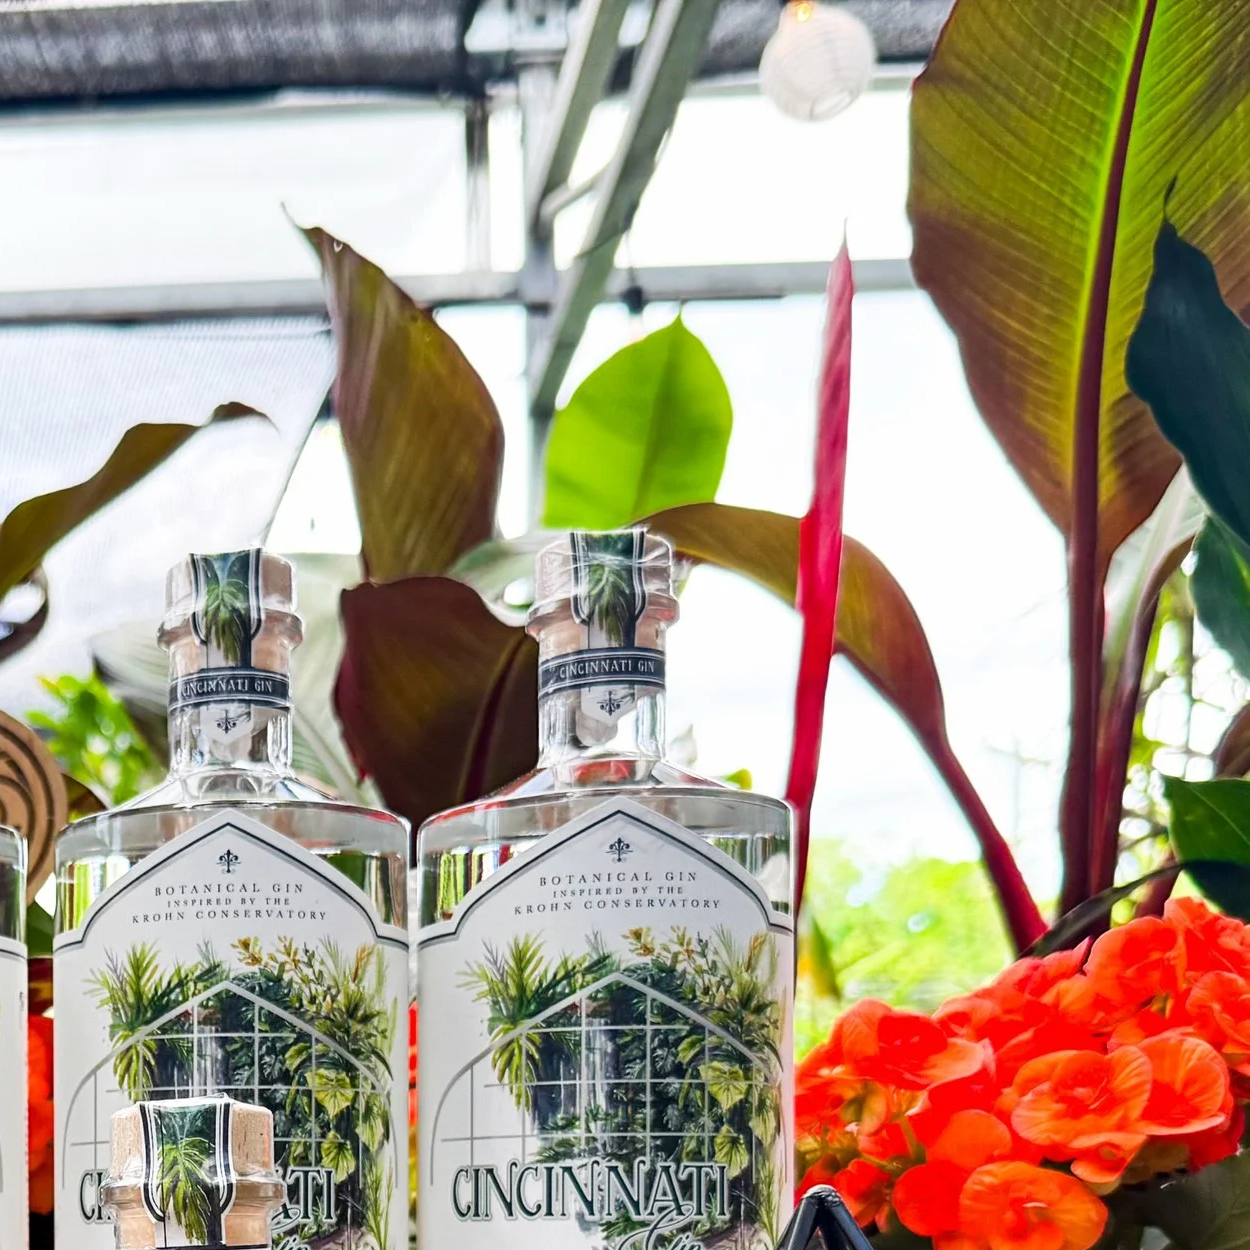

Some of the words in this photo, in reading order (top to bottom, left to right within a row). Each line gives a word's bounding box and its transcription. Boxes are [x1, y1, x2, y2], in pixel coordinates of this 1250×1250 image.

[559, 659, 632, 679] CINCINNATI
[637, 660, 655, 673] GIN
[254, 680, 273, 693] GIN
[539, 872, 652, 886] BOTANICAL
[665, 871, 697, 882] GIN
[155, 883, 260, 896] BOTANICAL
[272, 883, 303, 893] GIN
[553, 886, 623, 898] INSPIRED
[632, 886, 648, 894] BY
[658, 886, 683, 894] THE
[167, 897, 232, 908] INSPIRED
[240, 897, 255, 905] BY
[266, 897, 290, 905] THE
[514, 901, 573, 915] KROHN
[584, 899, 720, 910] CONSERVATORY
[132, 911, 185, 924] KROHN
[195, 909, 327, 921] CONSERVATORY
[451, 1160, 728, 1218] CINCINNATI
